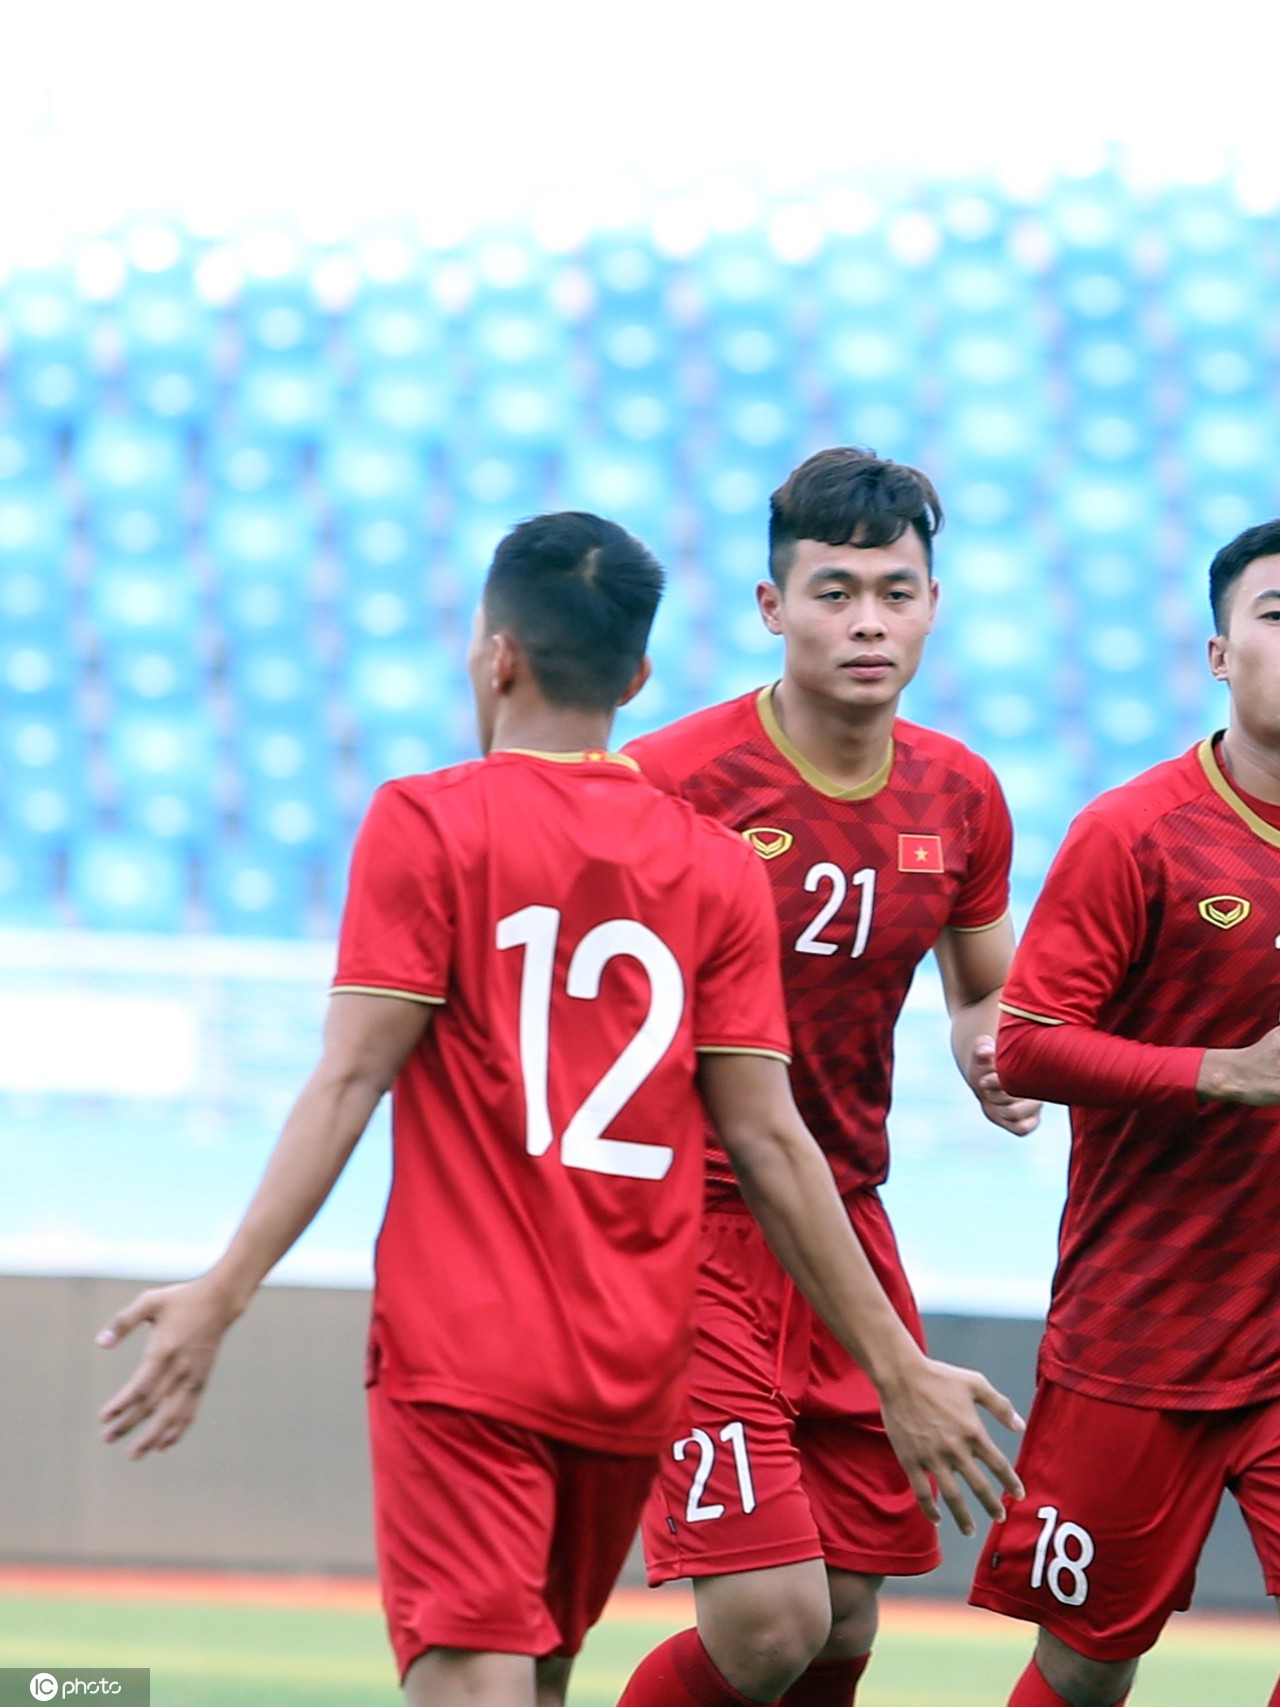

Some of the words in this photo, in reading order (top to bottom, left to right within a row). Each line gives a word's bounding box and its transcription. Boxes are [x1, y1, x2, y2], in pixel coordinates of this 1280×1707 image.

[795, 863, 876, 958] 21
[496, 905, 685, 1180] 12
[673, 1421, 757, 1522] 21
[1030, 1505, 1094, 1606] 18
